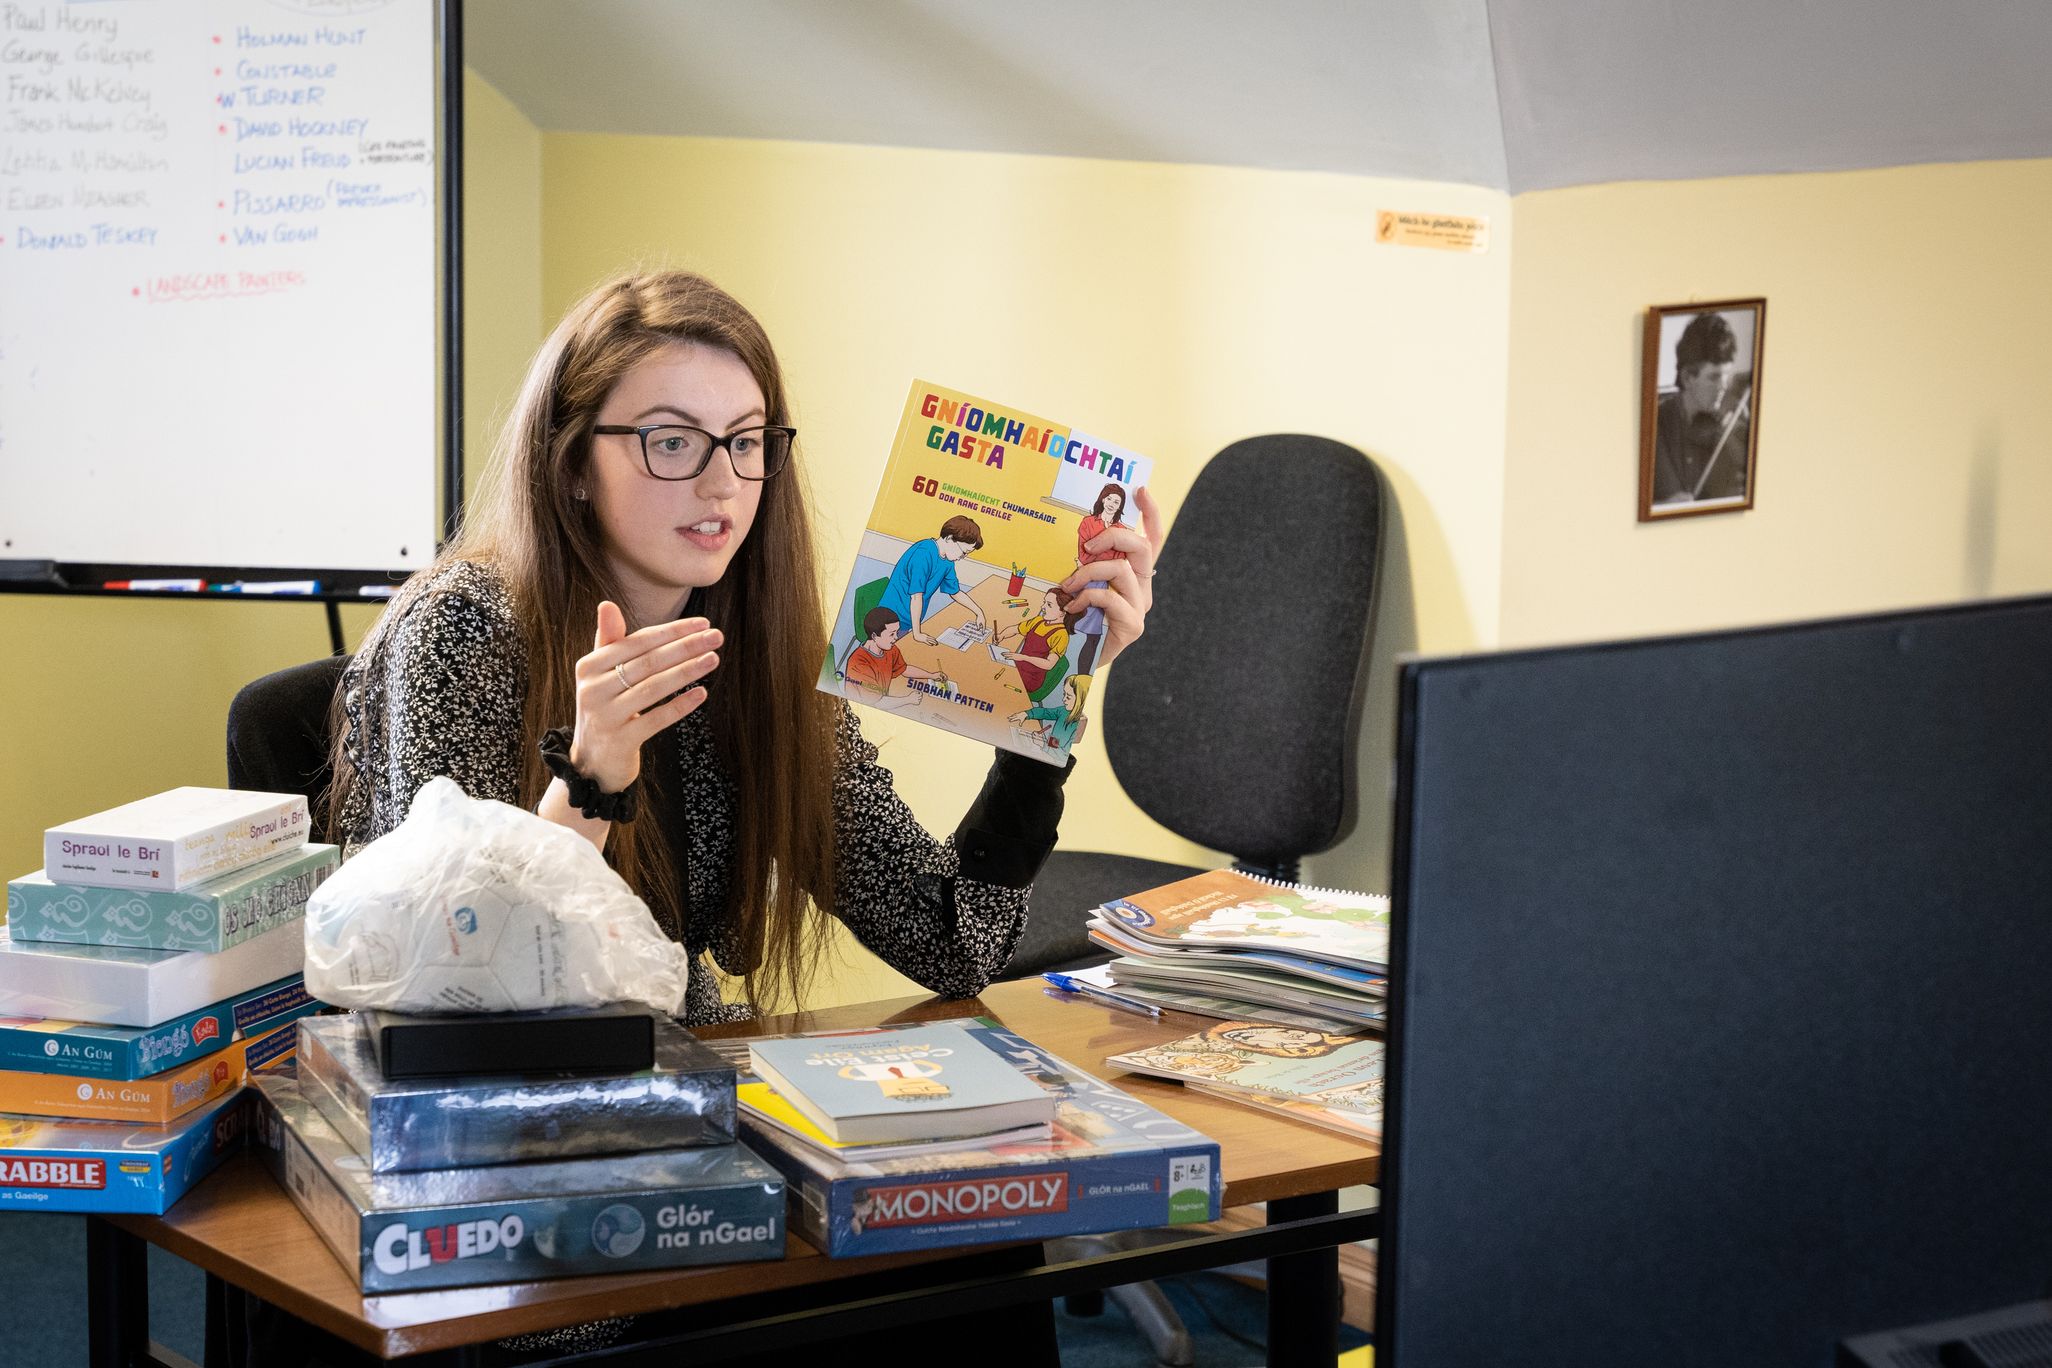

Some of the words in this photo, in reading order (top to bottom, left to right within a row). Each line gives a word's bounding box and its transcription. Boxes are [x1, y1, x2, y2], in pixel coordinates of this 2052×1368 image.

[57, 7, 118, 43] Henry
[921, 394, 1137, 484] GNÍOMHAÍOCHTAÍ
[926, 425, 1005, 470] GASTA
[912, 475, 939, 497] 60
[941, 482, 1001, 506] GNÍOMHAÍOCHT
[1002, 501, 1057, 525] CHUMARSÁIDE
[938, 492, 955, 504] DON
[957, 498, 978, 511] RANG
[980, 506, 1012, 521] GAEILGE
[954, 693, 994, 713] PATTEN
[62, 840, 110, 857] Spraoi
[117, 844, 131, 859] le
[138, 847, 160, 861] Brí
[657, 1204, 714, 1228] Glór
[874, 1178, 1063, 1221] MONOPOLY
[373, 1215, 525, 1275] CLUEDO
[657, 1230, 691, 1249] na
[699, 1217, 776, 1245] nGael
